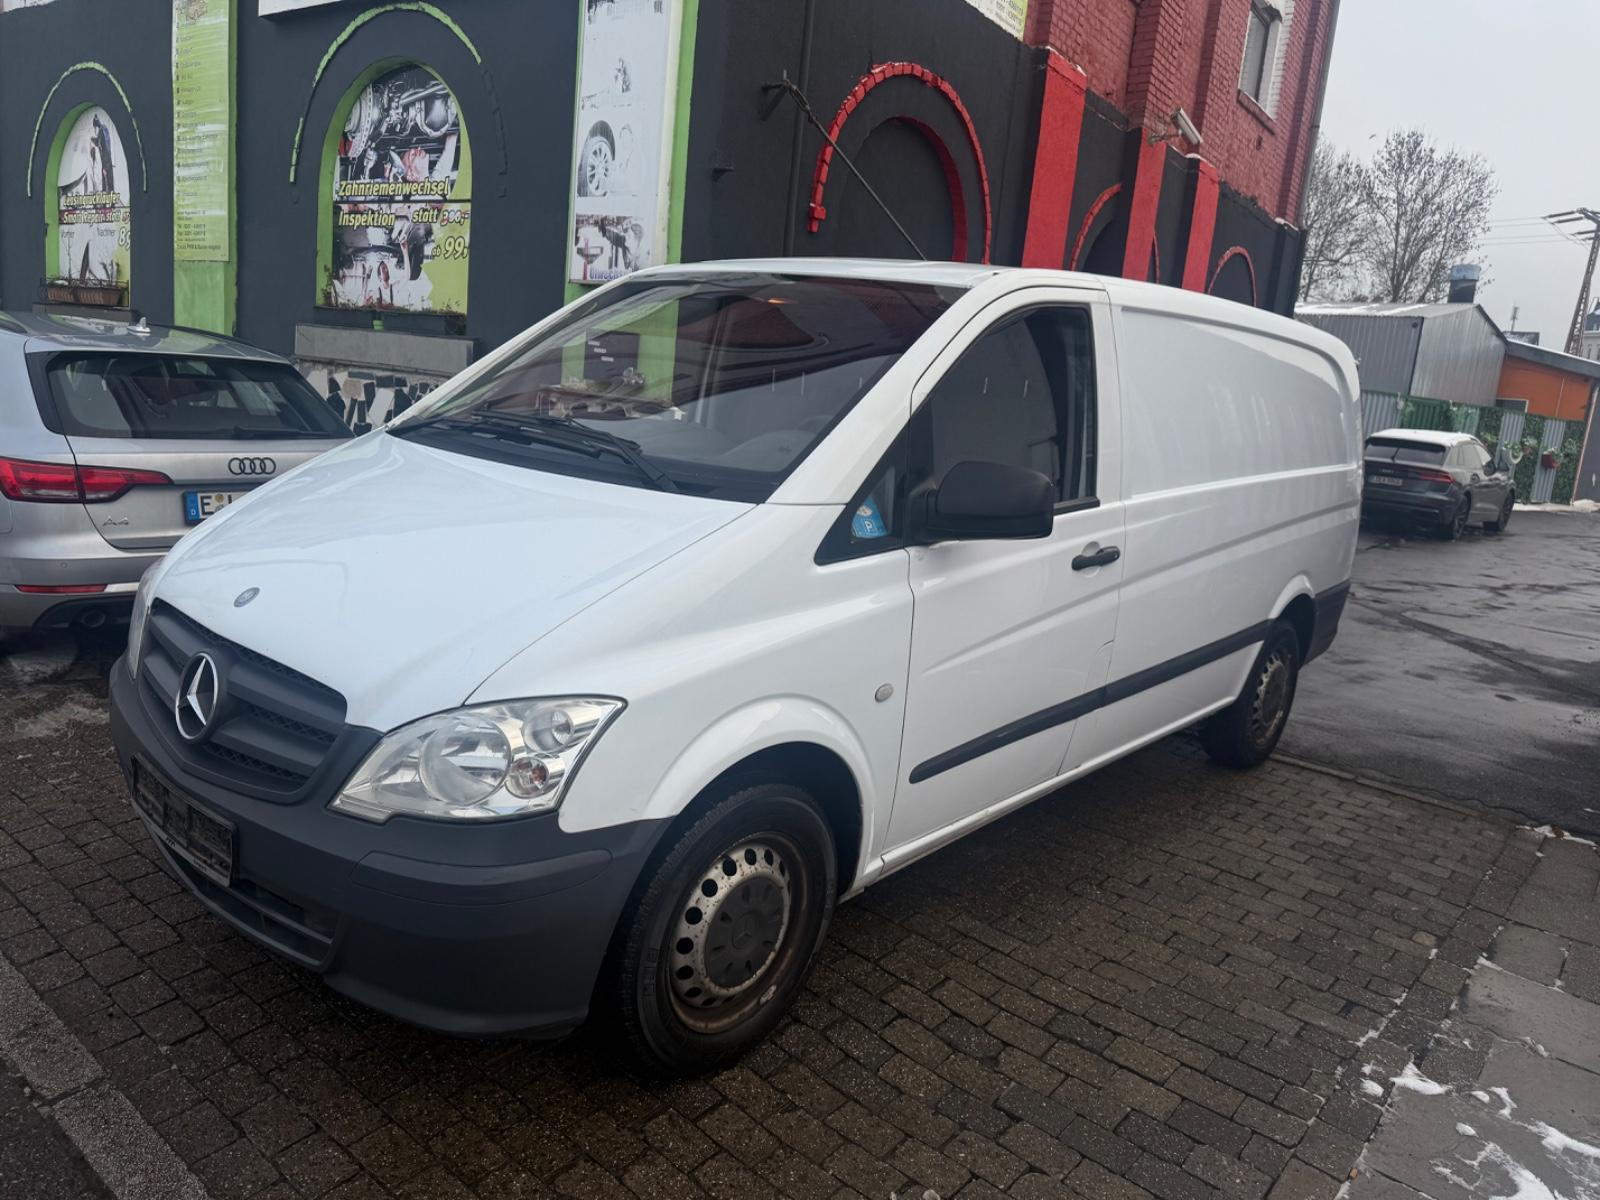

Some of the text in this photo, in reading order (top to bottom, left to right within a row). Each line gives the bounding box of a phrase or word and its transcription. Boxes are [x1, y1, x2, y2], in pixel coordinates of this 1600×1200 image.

[339, 176, 450, 197] Zahnriemenwechsel
[338, 210, 396, 230] Inspektion
[411, 207, 439, 224] statt
[200, 495, 214, 516] E
